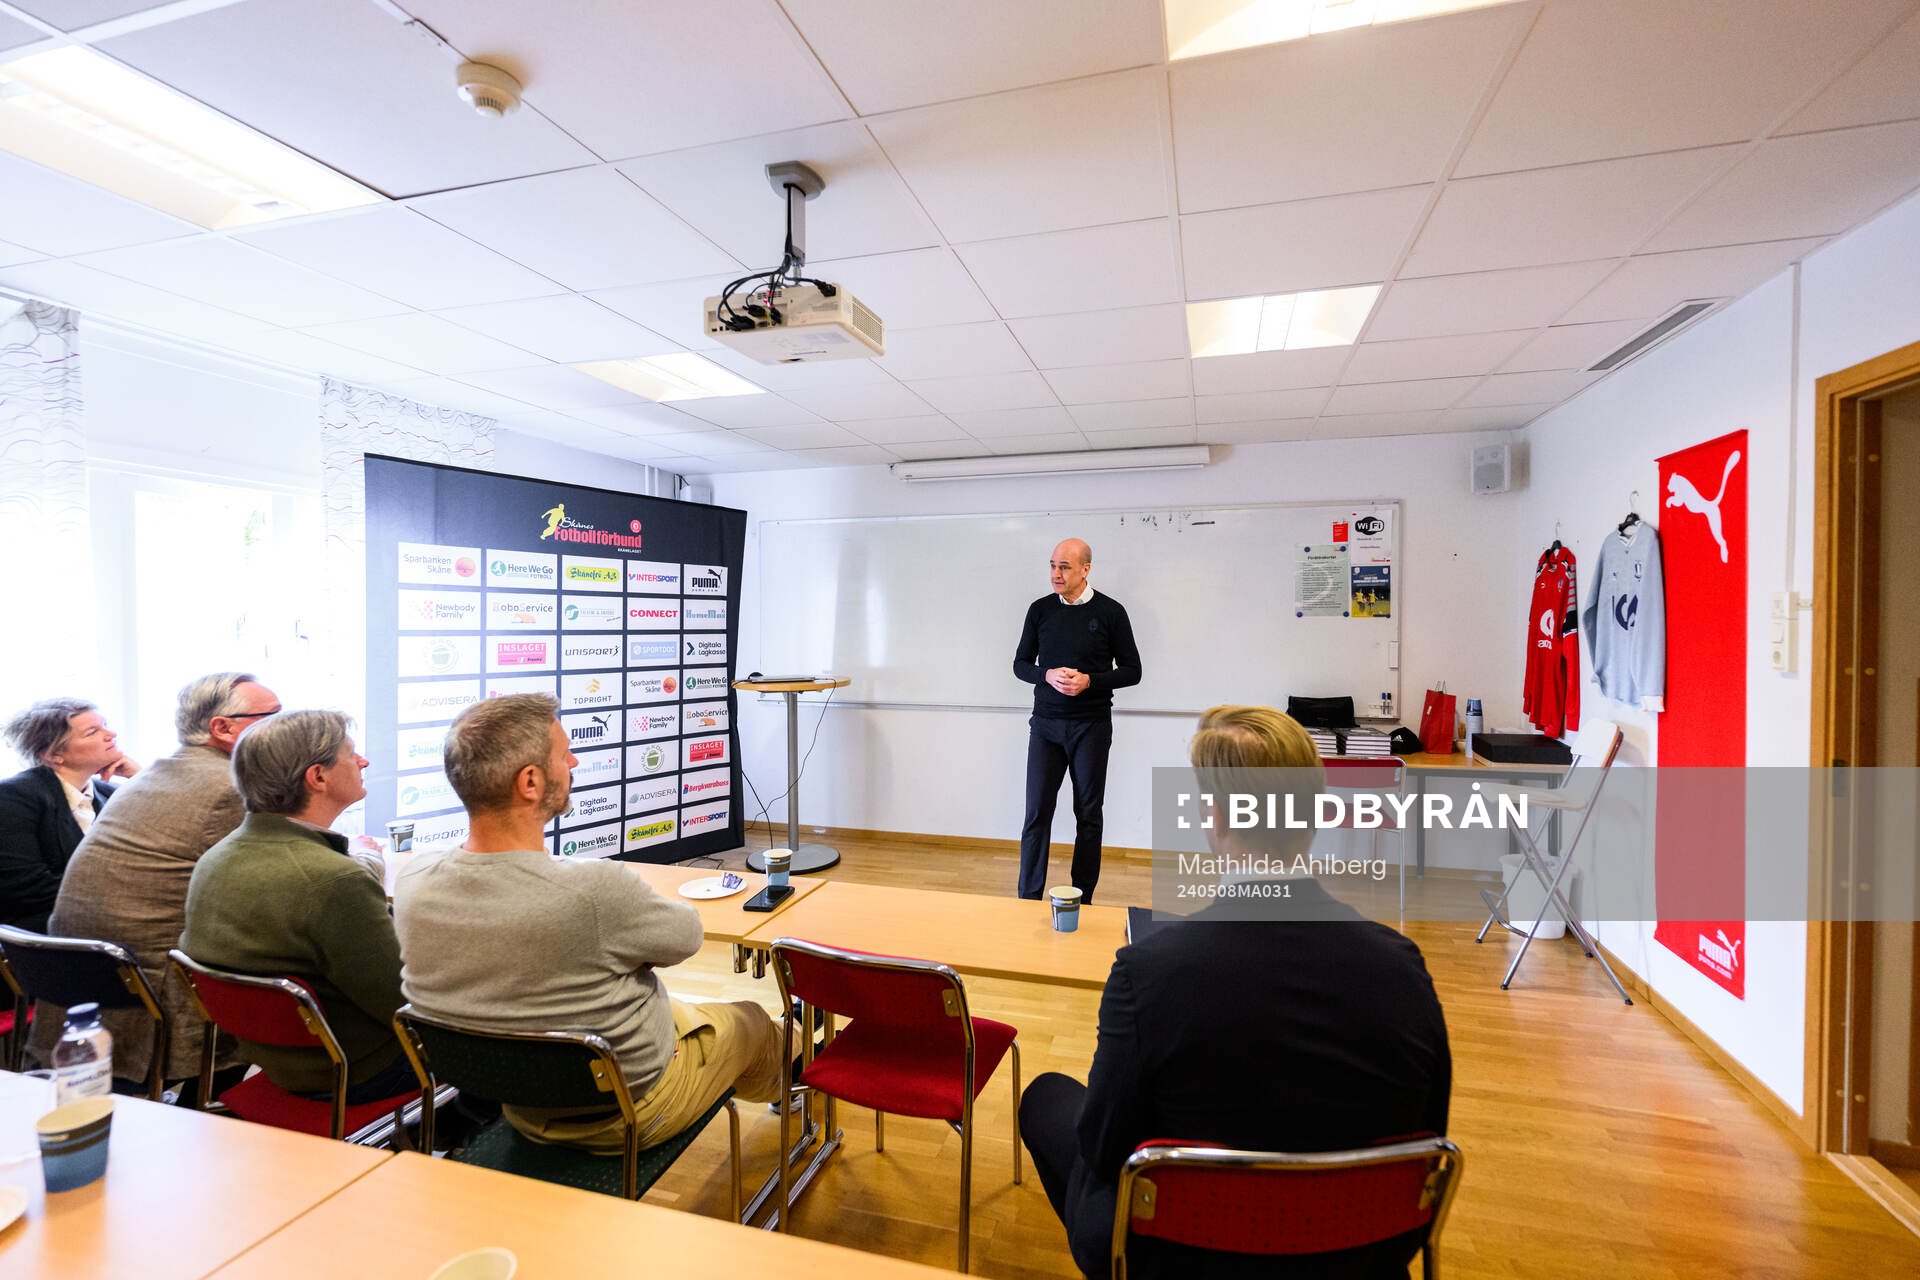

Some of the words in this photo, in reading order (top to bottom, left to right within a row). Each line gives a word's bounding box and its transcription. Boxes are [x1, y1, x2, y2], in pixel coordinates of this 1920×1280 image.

[559, 517, 594, 529] Skånes
[554, 526, 642, 548] Fotbollförbund
[403, 554, 452, 565] Sparbanken
[427, 565, 451, 575] Skåne
[508, 563, 527, 573] Here
[528, 565, 542, 574] We
[542, 566, 554, 575] Go
[636, 574, 678, 583] INTERSPORT
[692, 577, 718, 588] PUMA
[436, 604, 476, 614] Newbody
[629, 609, 678, 618] CONNECT
[436, 611, 464, 620] Family
[498, 643, 545, 652] INSLAGET
[698, 641, 722, 651] Digitala
[630, 679, 661, 689] Sparbanken
[697, 676, 711, 685] Here
[711, 675, 722, 684] We
[573, 695, 612, 705] TOPRIGHT
[649, 714, 675, 723] Newbody
[649, 721, 668, 730] Family
[571, 726, 603, 740] PUMA
[639, 788, 677, 801] ADVISERA
[580, 796, 608, 808] Digitala
[580, 803, 618, 816] Lagkassan
[689, 811, 728, 826] INTERSPORT
[578, 839, 596, 850] Here
[595, 836, 608, 846] We
[608, 833, 618, 843] Go
